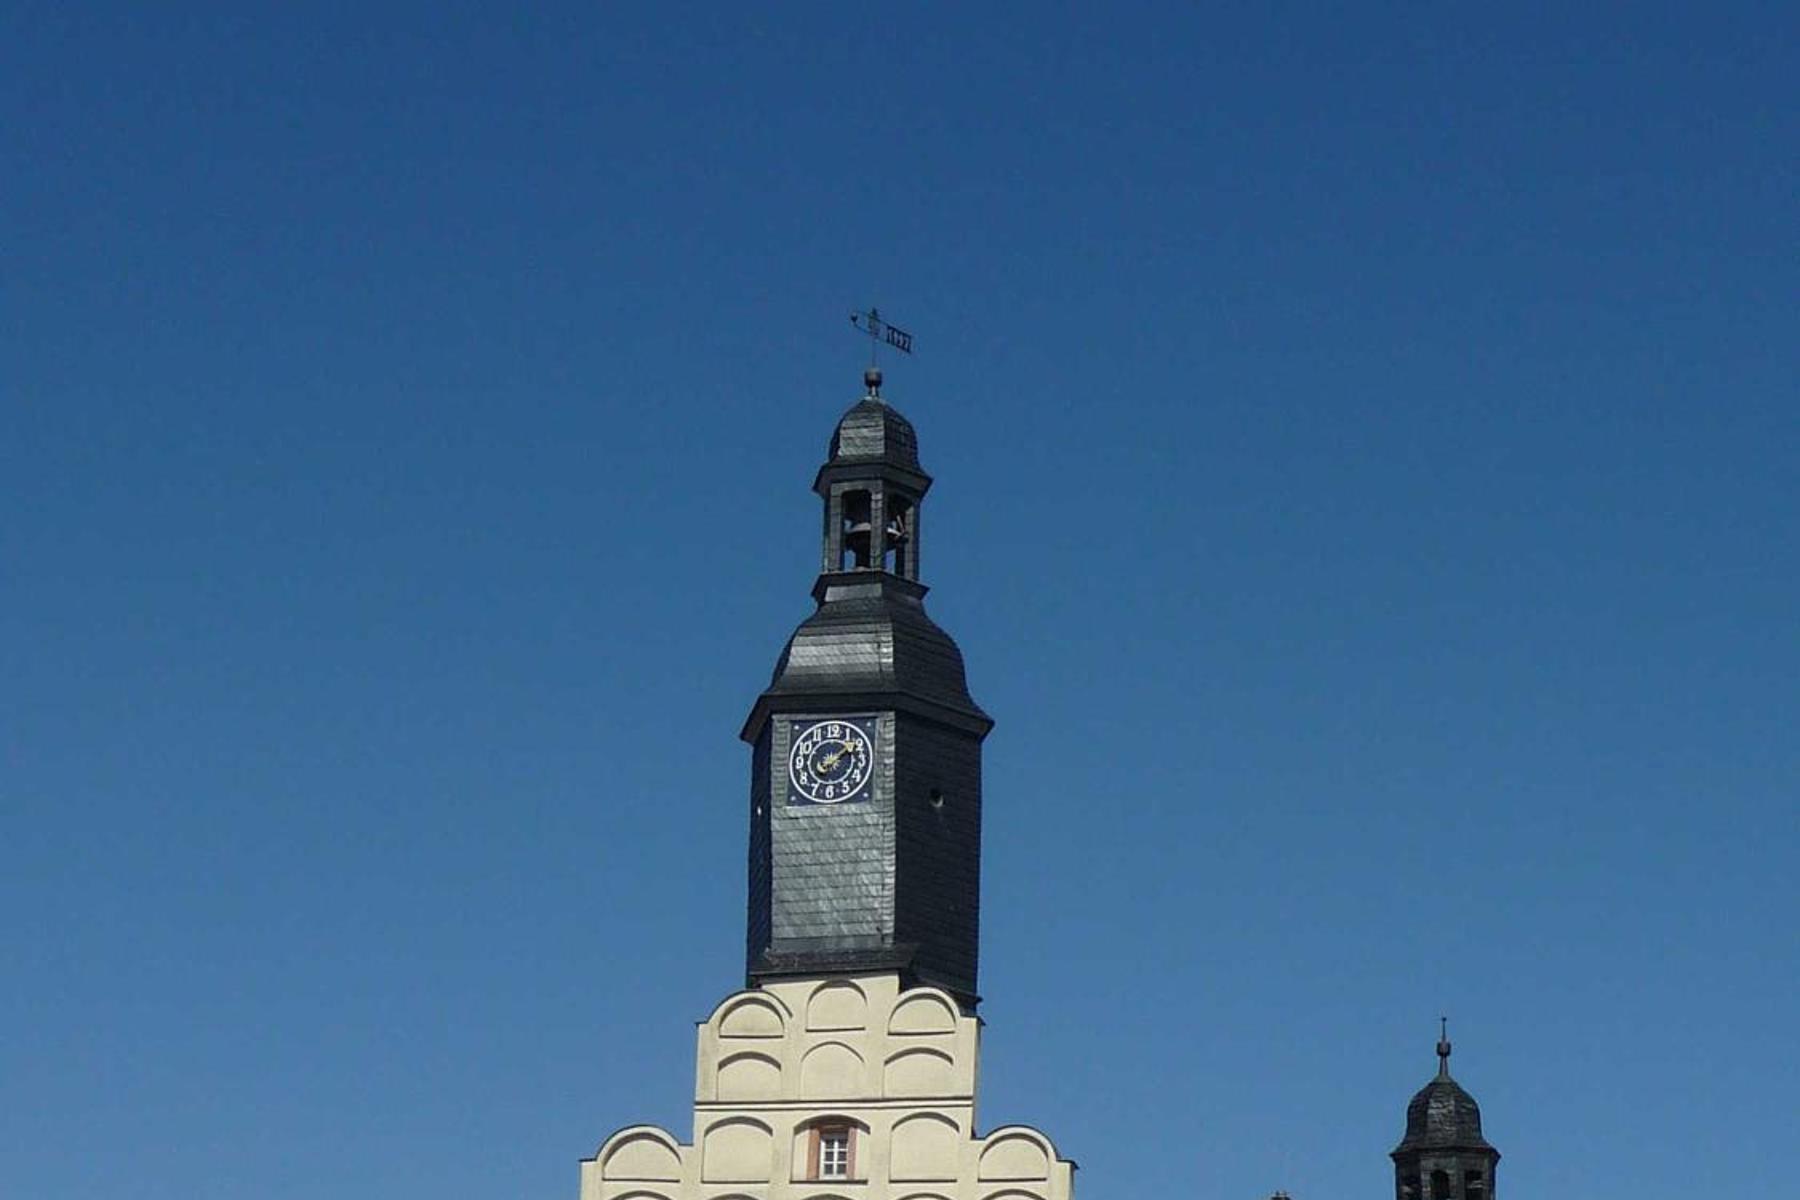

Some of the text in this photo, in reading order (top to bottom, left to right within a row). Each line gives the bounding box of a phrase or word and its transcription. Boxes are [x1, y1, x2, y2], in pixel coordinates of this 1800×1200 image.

[813, 728, 821, 741] 11
[827, 724, 840, 738] 12
[845, 728, 850, 741] 1
[800, 740, 812, 755] 10
[855, 738, 864, 752] 2
[796, 756, 804, 769] 9
[800, 771, 808, 785] 8
[852, 769, 861, 782] 4
[811, 782, 820, 796] 7
[825, 785, 834, 798] 6
[842, 780, 850, 793] 5
